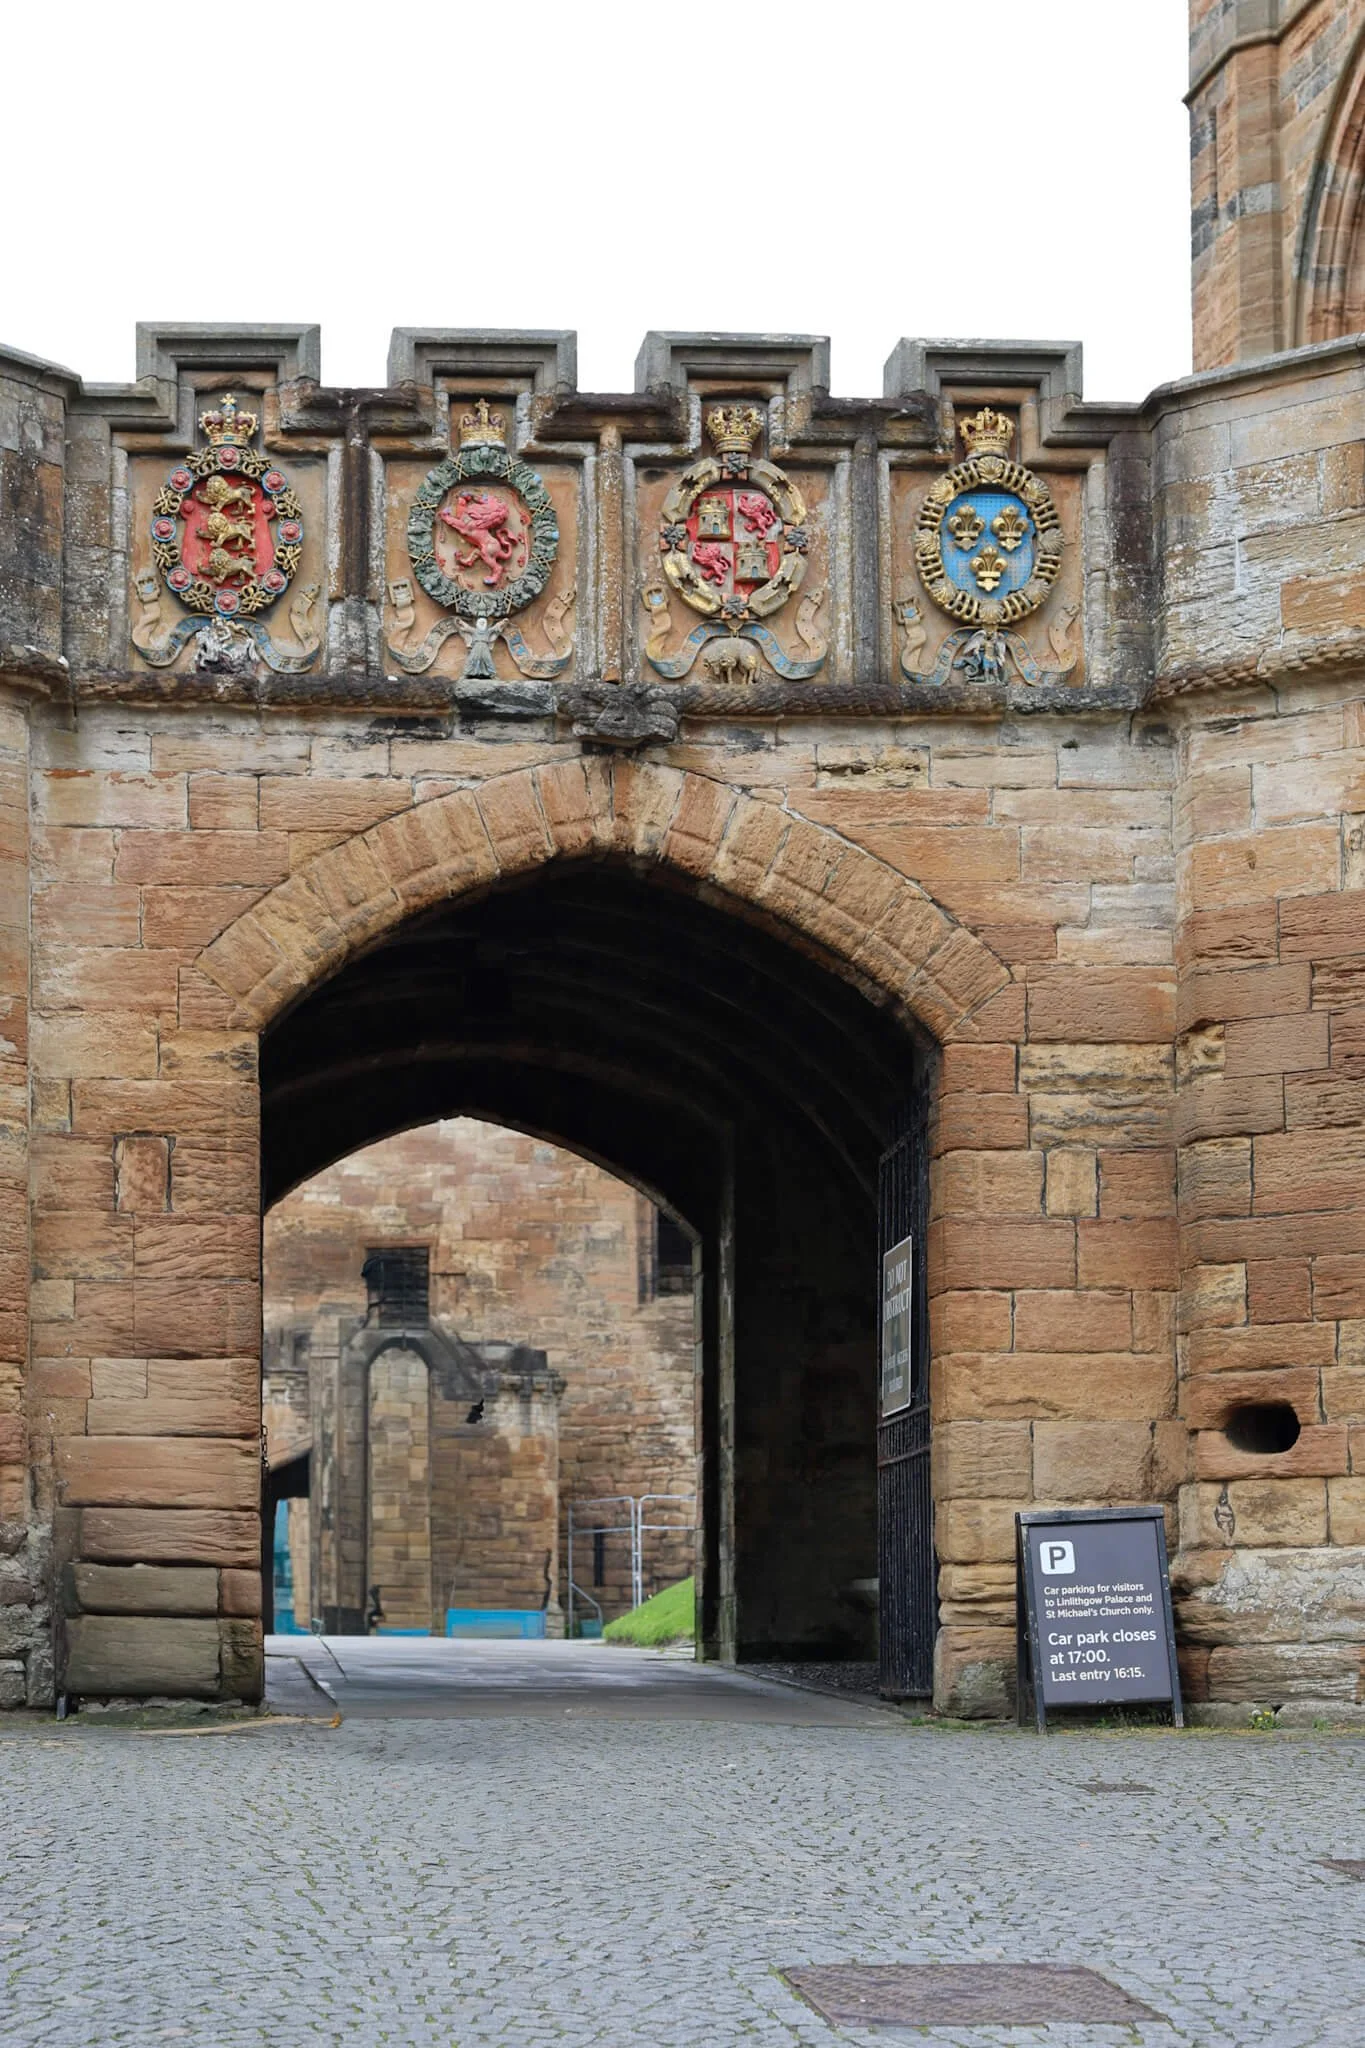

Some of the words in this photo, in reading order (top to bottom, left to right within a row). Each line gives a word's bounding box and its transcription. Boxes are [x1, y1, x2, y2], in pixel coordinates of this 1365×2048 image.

[895, 1259, 908, 1287] NOT
[1048, 1546, 1066, 1569] P
[1044, 1586, 1060, 1595] Car
[1061, 1585, 1095, 1595] parking
[1097, 1583, 1110, 1593] for
[1112, 1582, 1144, 1592] visitors
[1044, 1598, 1055, 1607] to
[1056, 1596, 1102, 1607] Linlithgow
[1104, 1594, 1134, 1604] Palace
[1135, 1593, 1153, 1603] and
[1045, 1610, 1055, 1619] St
[1057, 1608, 1098, 1618] Michael's
[1099, 1606, 1131, 1617] Church
[1132, 1605, 1154, 1615] only.
[1048, 1632, 1073, 1646] Car
[1077, 1629, 1110, 1647] park
[1112, 1628, 1157, 1643] closes
[1049, 1651, 1065, 1665] at
[1067, 1649, 1111, 1664] 17:00.
[1051, 1670, 1078, 1682] Last
[1079, 1669, 1112, 1681] entry
[1113, 1666, 1146, 1679] 16:15.
